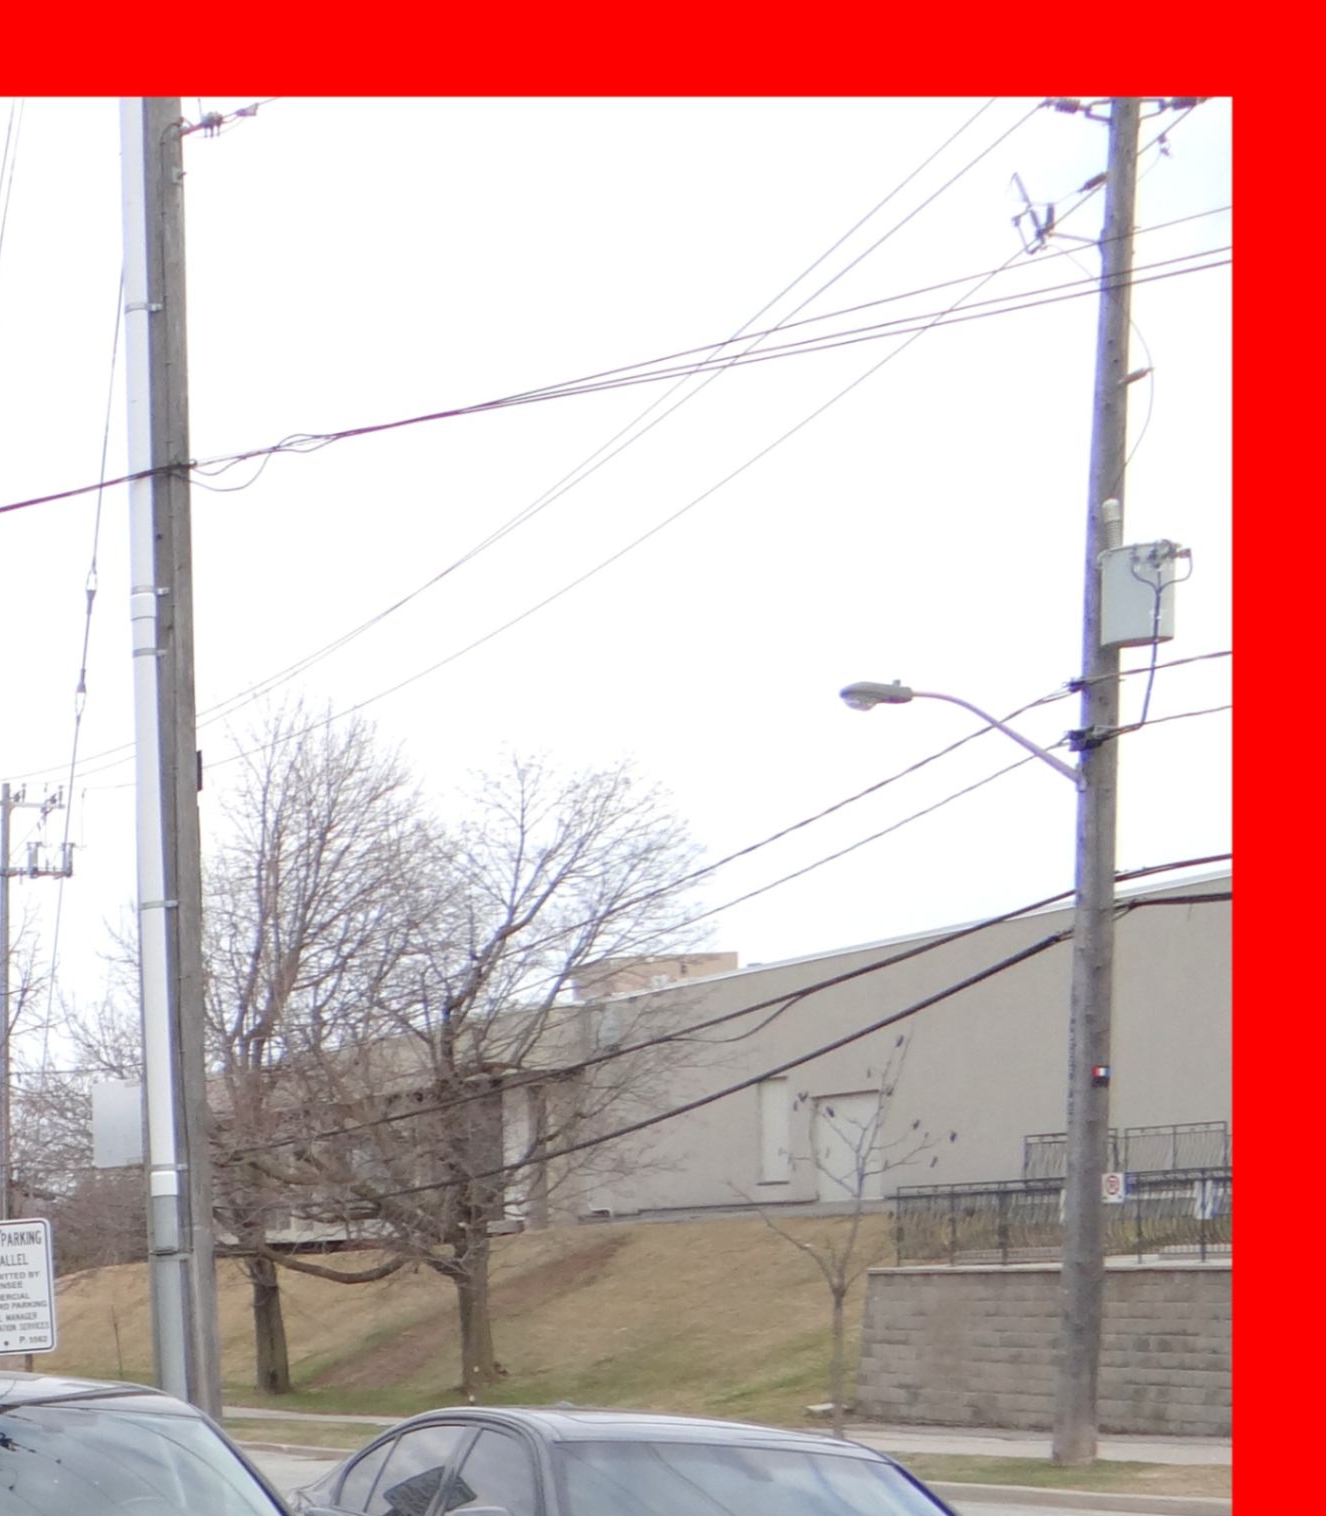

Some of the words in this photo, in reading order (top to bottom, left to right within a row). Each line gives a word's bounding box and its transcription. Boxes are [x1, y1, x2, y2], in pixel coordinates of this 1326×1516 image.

[1, 1230, 41, 1247] PARKING
[28, 1270, 40, 1278] BY
[11, 1300, 47, 1309] PARKING
[5, 1312, 37, 1321] MANAGER
